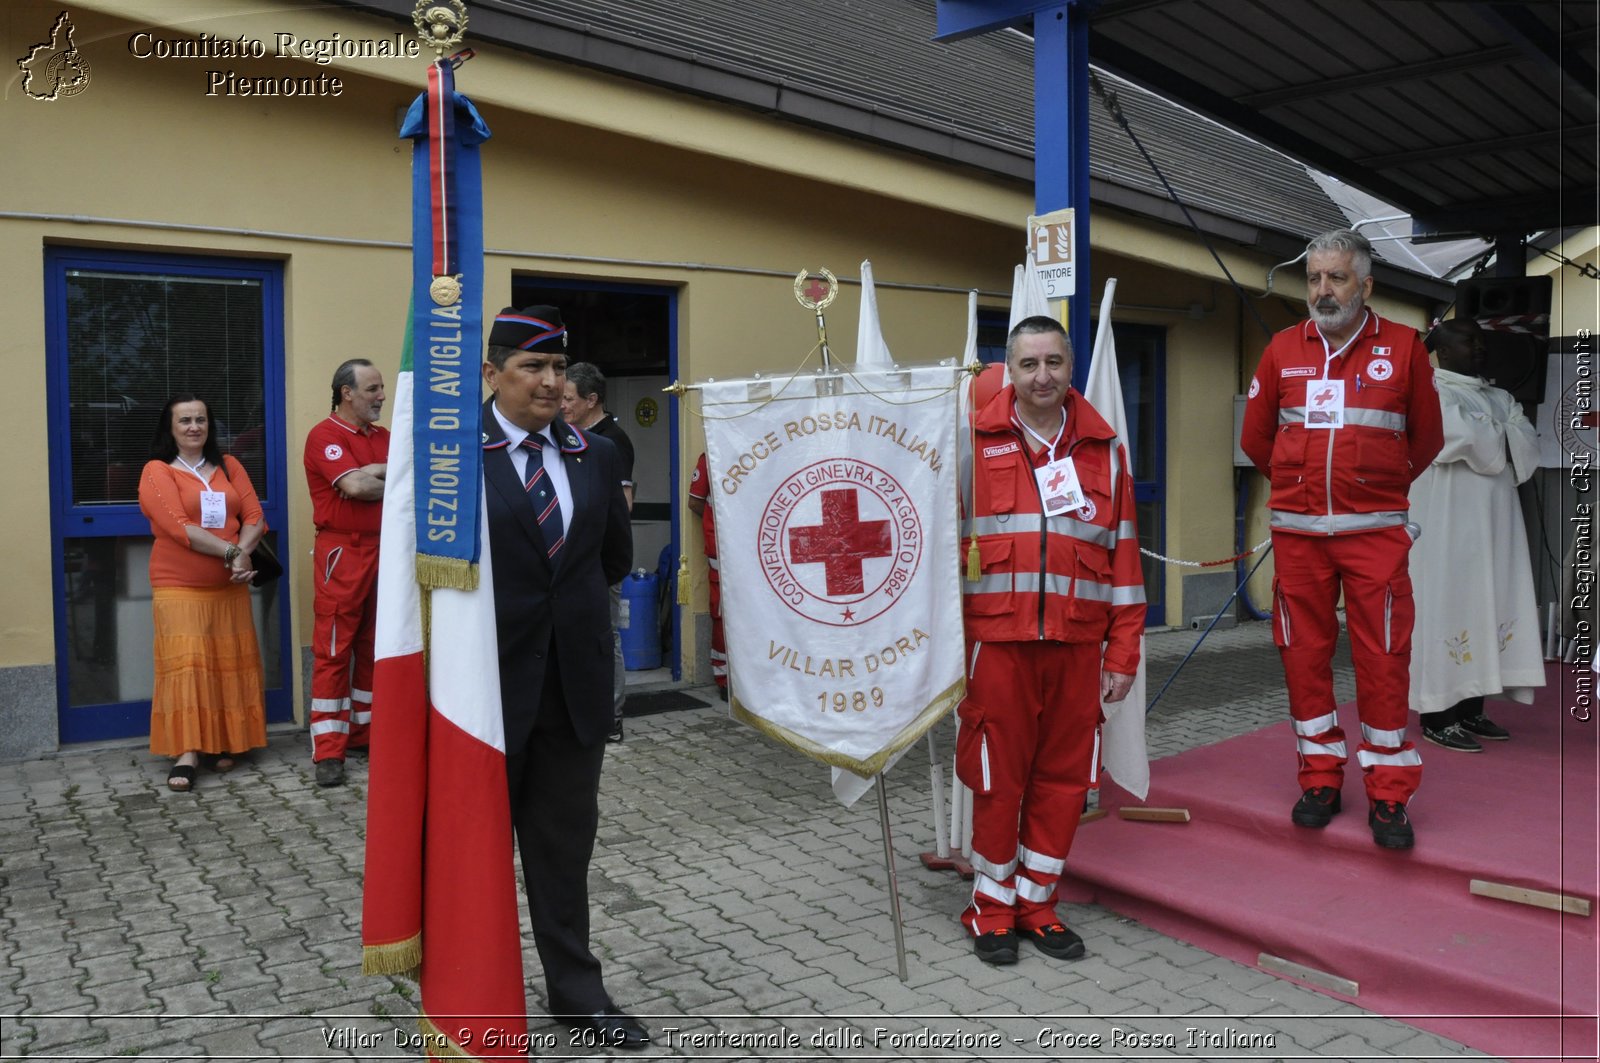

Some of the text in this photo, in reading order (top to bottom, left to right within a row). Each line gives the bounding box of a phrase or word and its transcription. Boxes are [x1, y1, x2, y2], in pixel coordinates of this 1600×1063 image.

[1037, 267, 1072, 280] TINTORE
[1047, 280, 1056, 295] 5
[427, 273, 463, 542] SEZIONE DI AVIGLIA
[721, 411, 943, 495] CROCE ROSSA ITALIANA
[985, 446, 1010, 455] Vittorio
[762, 463, 918, 606] CONVENZIONE DI GINEVRA 22 AGOSTO 1864
[768, 627, 930, 678] VILLAR DORA
[817, 686, 884, 713] 1989
